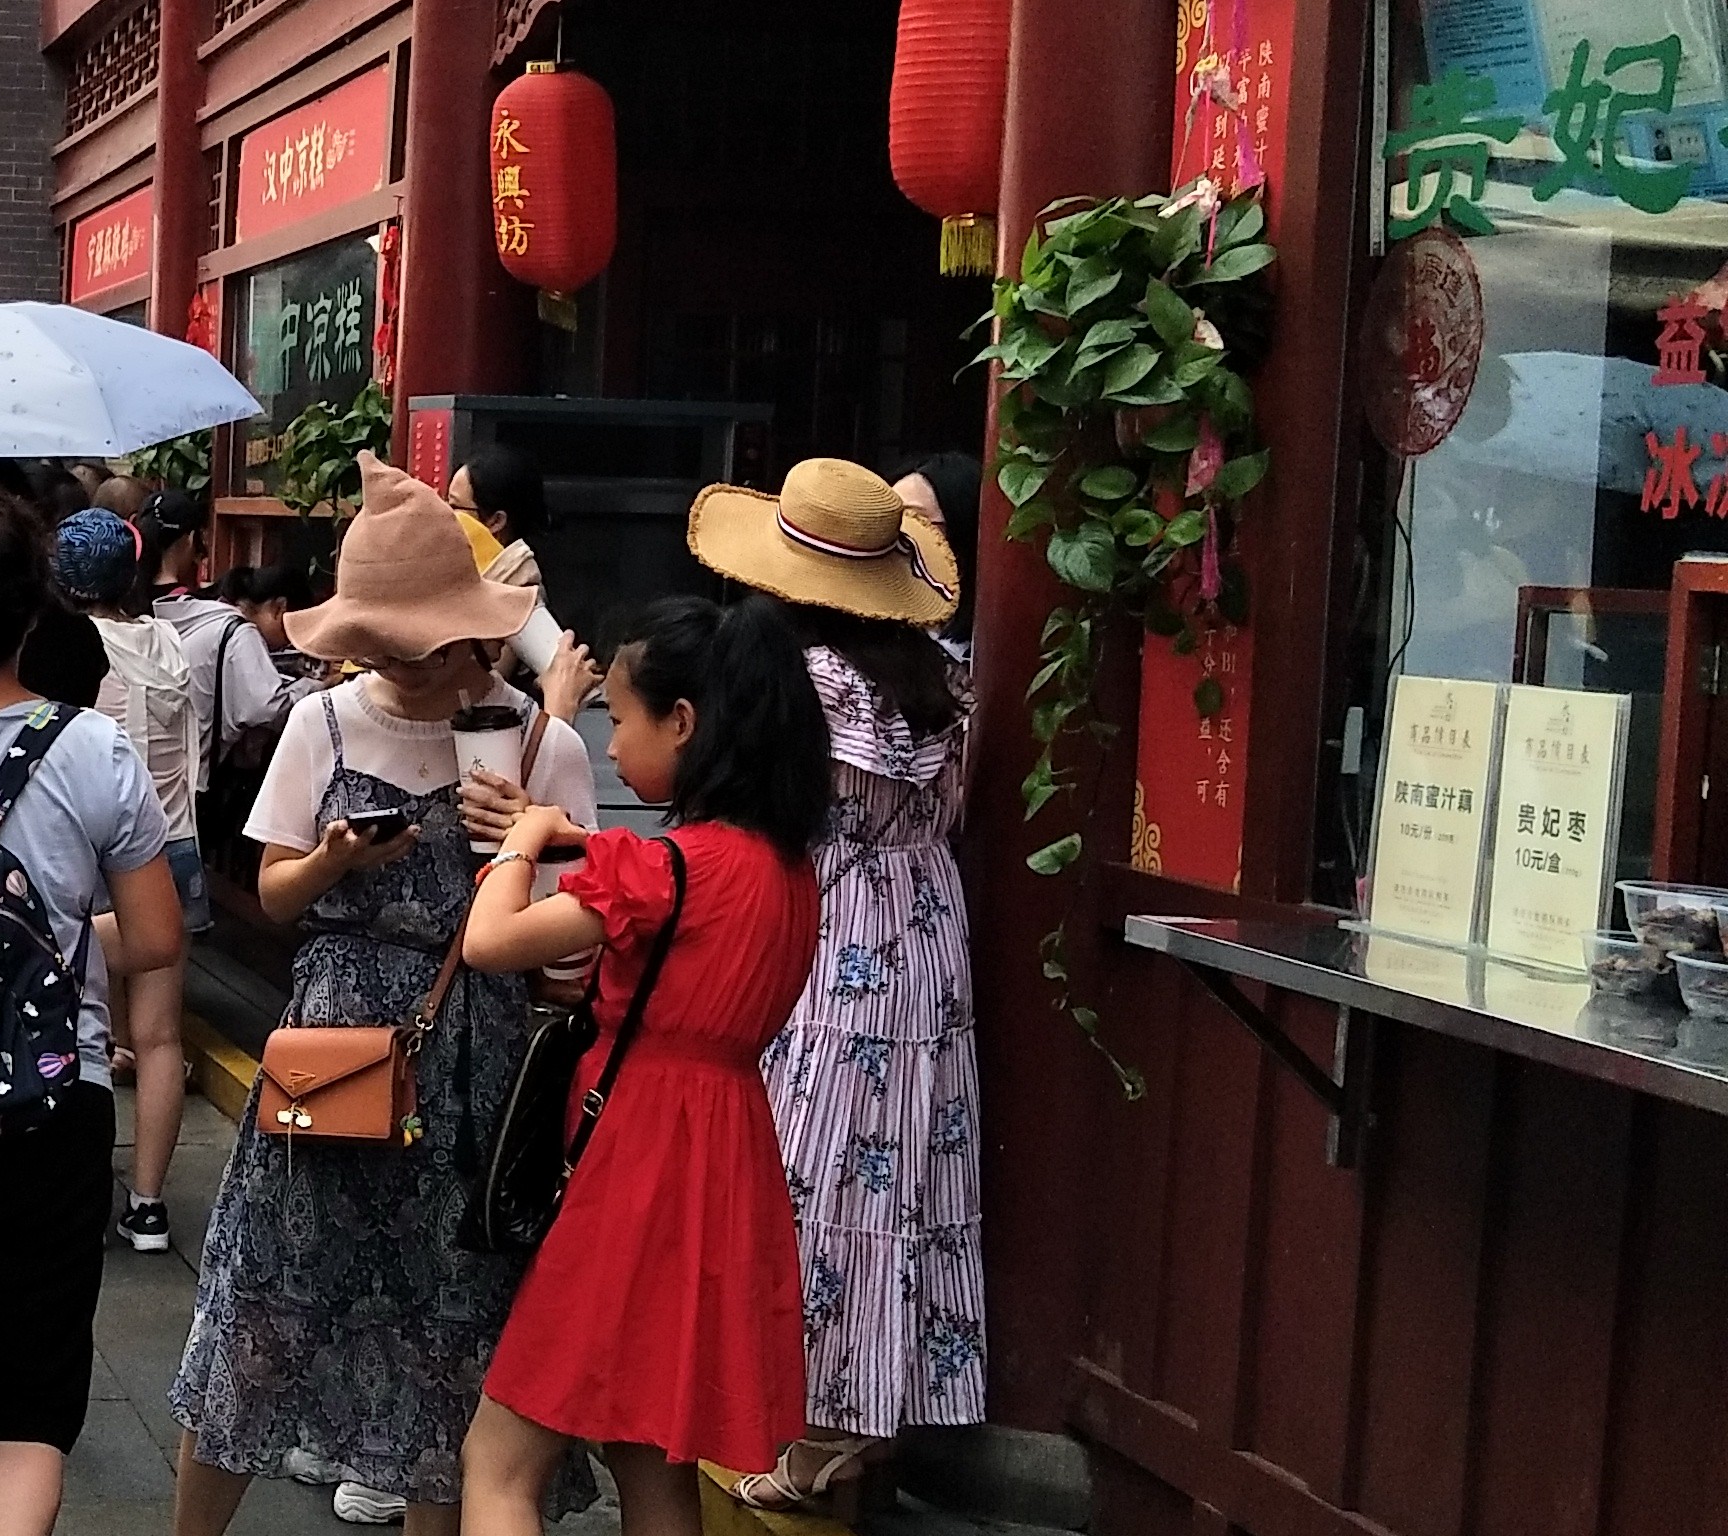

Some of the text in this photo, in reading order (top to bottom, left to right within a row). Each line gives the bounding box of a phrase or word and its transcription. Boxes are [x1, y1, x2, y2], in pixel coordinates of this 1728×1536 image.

[261, 119, 327, 207] 汉中凉糕
[1382, 33, 1728, 241] 贵妃
[492, 108, 536, 256] 永興坊
[270, 276, 363, 392] 中凉糕
[1651, 292, 1728, 387] 益
[1394, 779, 1475, 815] 陕南蜜汁藕
[1399, 821, 1434, 843] 10元/份
[1516, 803, 1588, 843] 贵妃枣
[1514, 846, 1563, 876] 10元/盒
